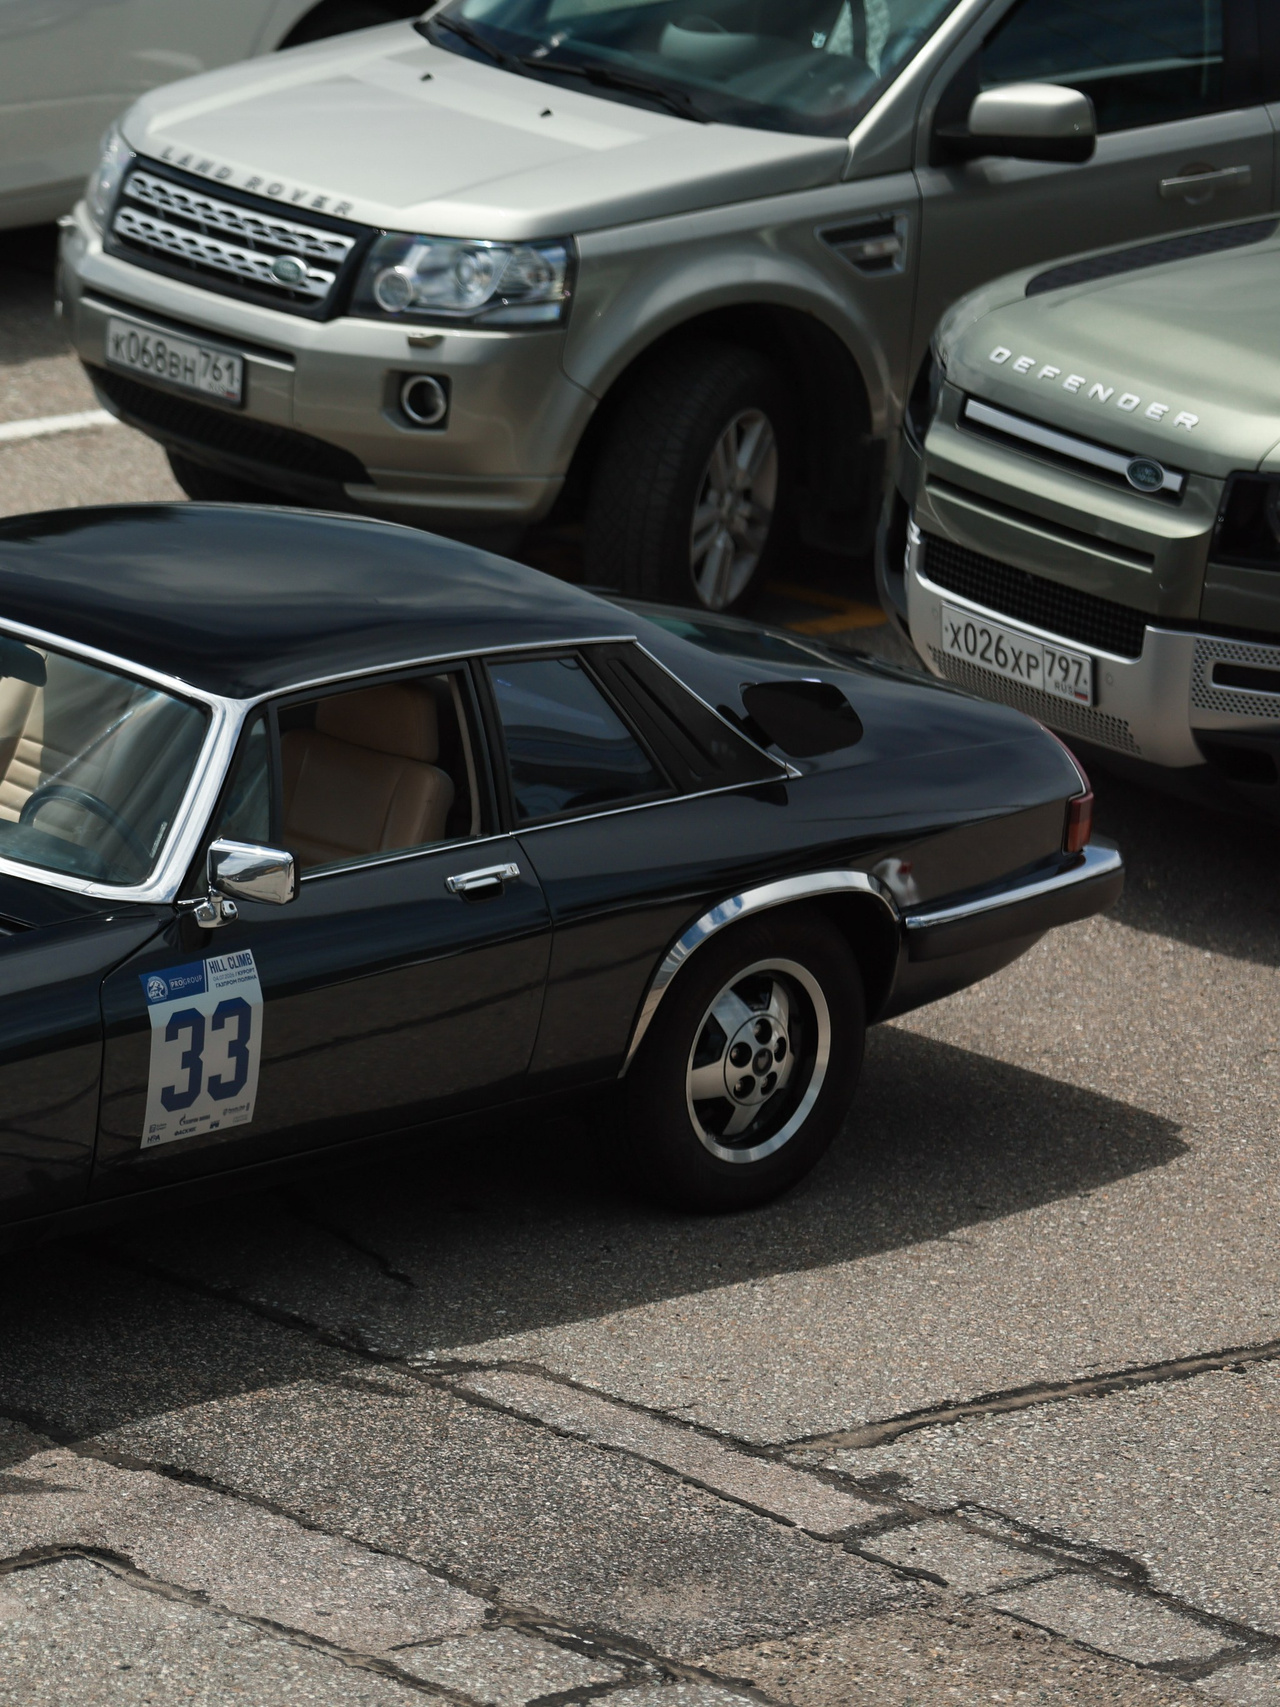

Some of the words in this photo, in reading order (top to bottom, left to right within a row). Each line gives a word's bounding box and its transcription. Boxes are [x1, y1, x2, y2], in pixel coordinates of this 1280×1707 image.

[161, 147, 233, 180] LAND
[245, 176, 355, 217] ROVER
[988, 345, 1200, 432] DEFENDER
[1045, 651, 1083, 687] 797
[1054, 681, 1074, 695] RUS
[208, 960, 228, 974] HILL
[228, 952, 253, 970] CLIMB
[160, 996, 252, 1112] 33
